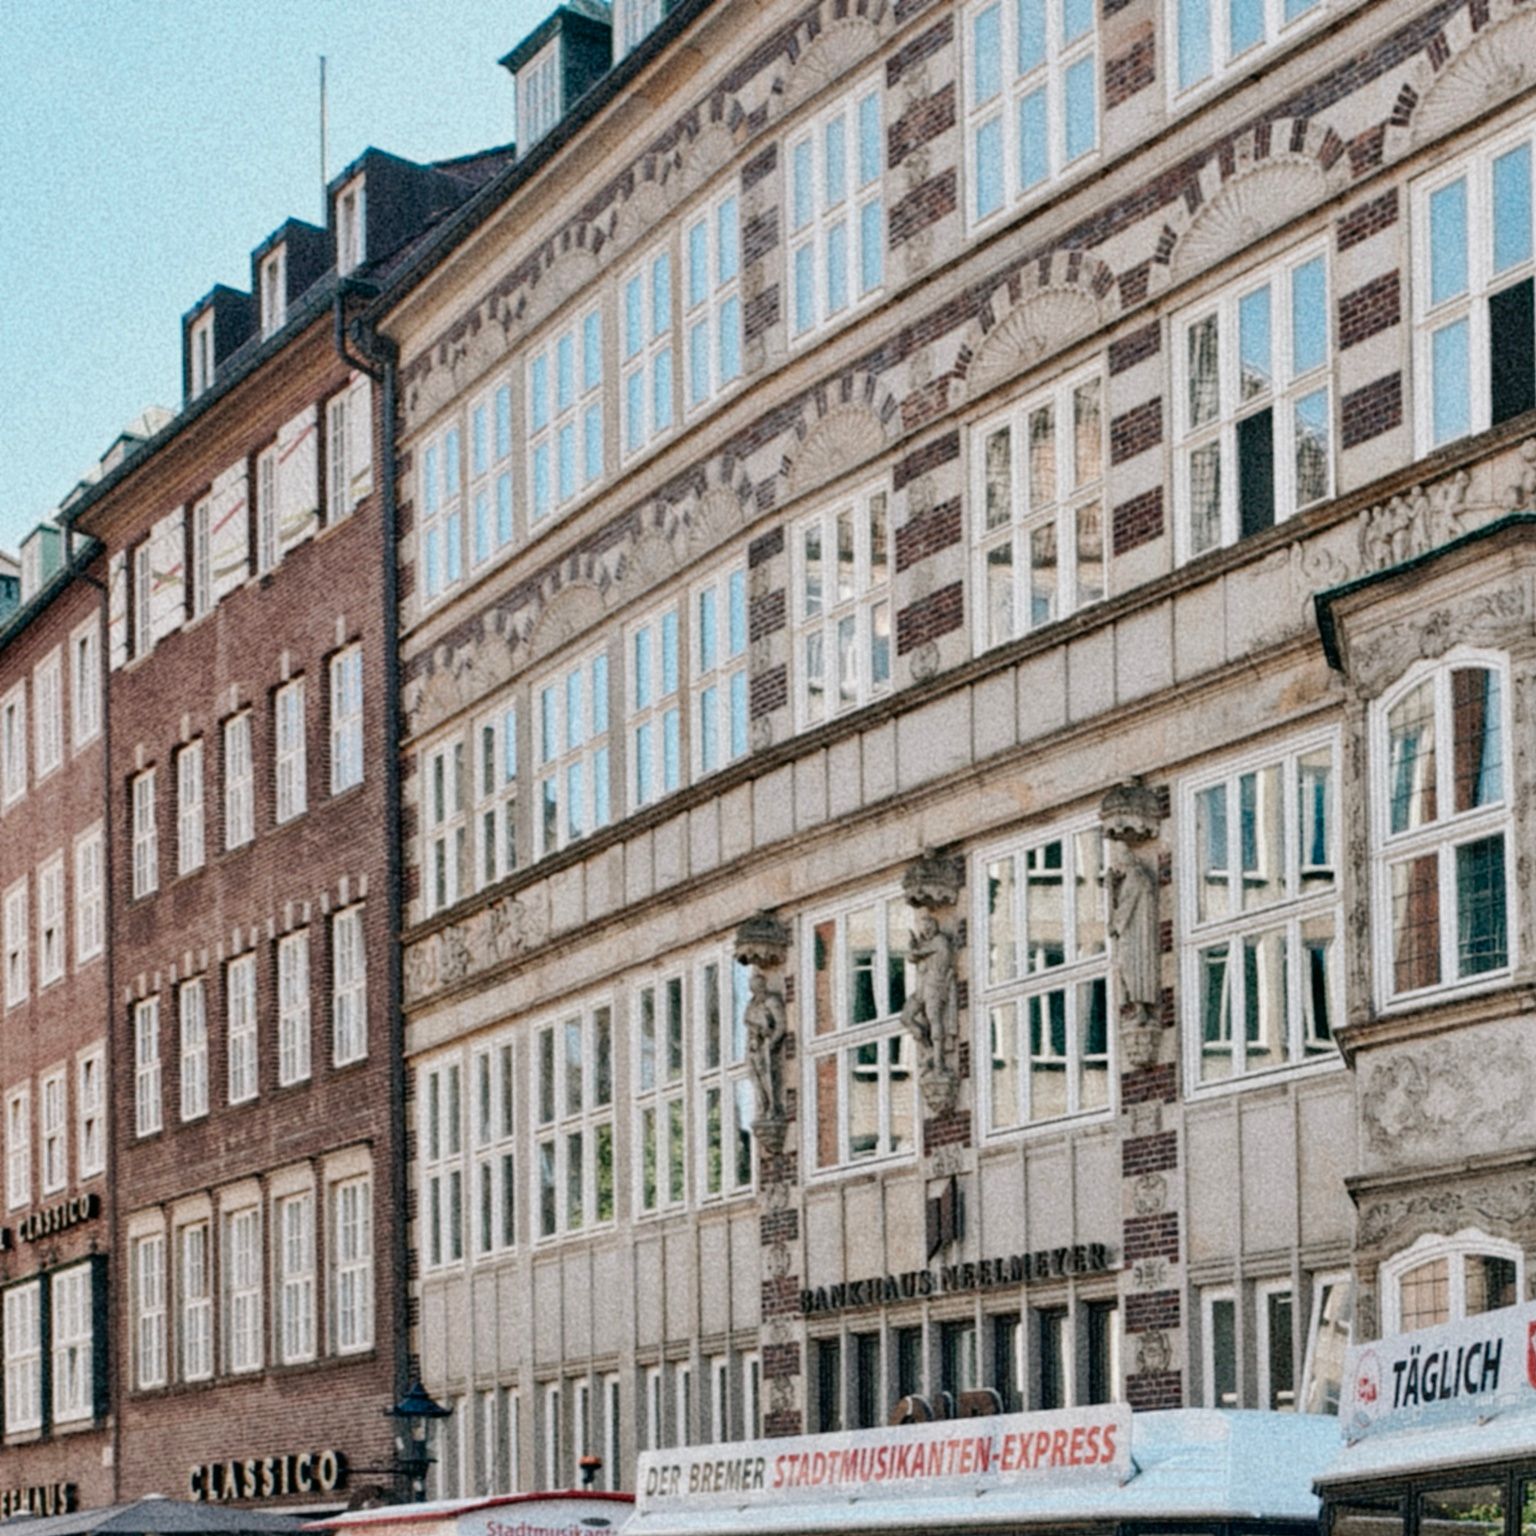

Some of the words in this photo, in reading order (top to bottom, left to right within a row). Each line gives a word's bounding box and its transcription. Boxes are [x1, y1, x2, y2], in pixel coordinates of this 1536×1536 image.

[16, 1194, 91, 1243] CLASSICO
[799, 1268, 934, 1313] BANKHAUS
[940, 1243, 1108, 1291] NEELMEYER
[1393, 1337, 1503, 1409] TÄGLICH
[188, 1449, 338, 1501] CLASSICO
[645, 1465, 682, 1497] DER
[688, 1457, 766, 1493] BREMER
[773, 1424, 1118, 1489] STADTMUSIKANTEN-EXPRESS
